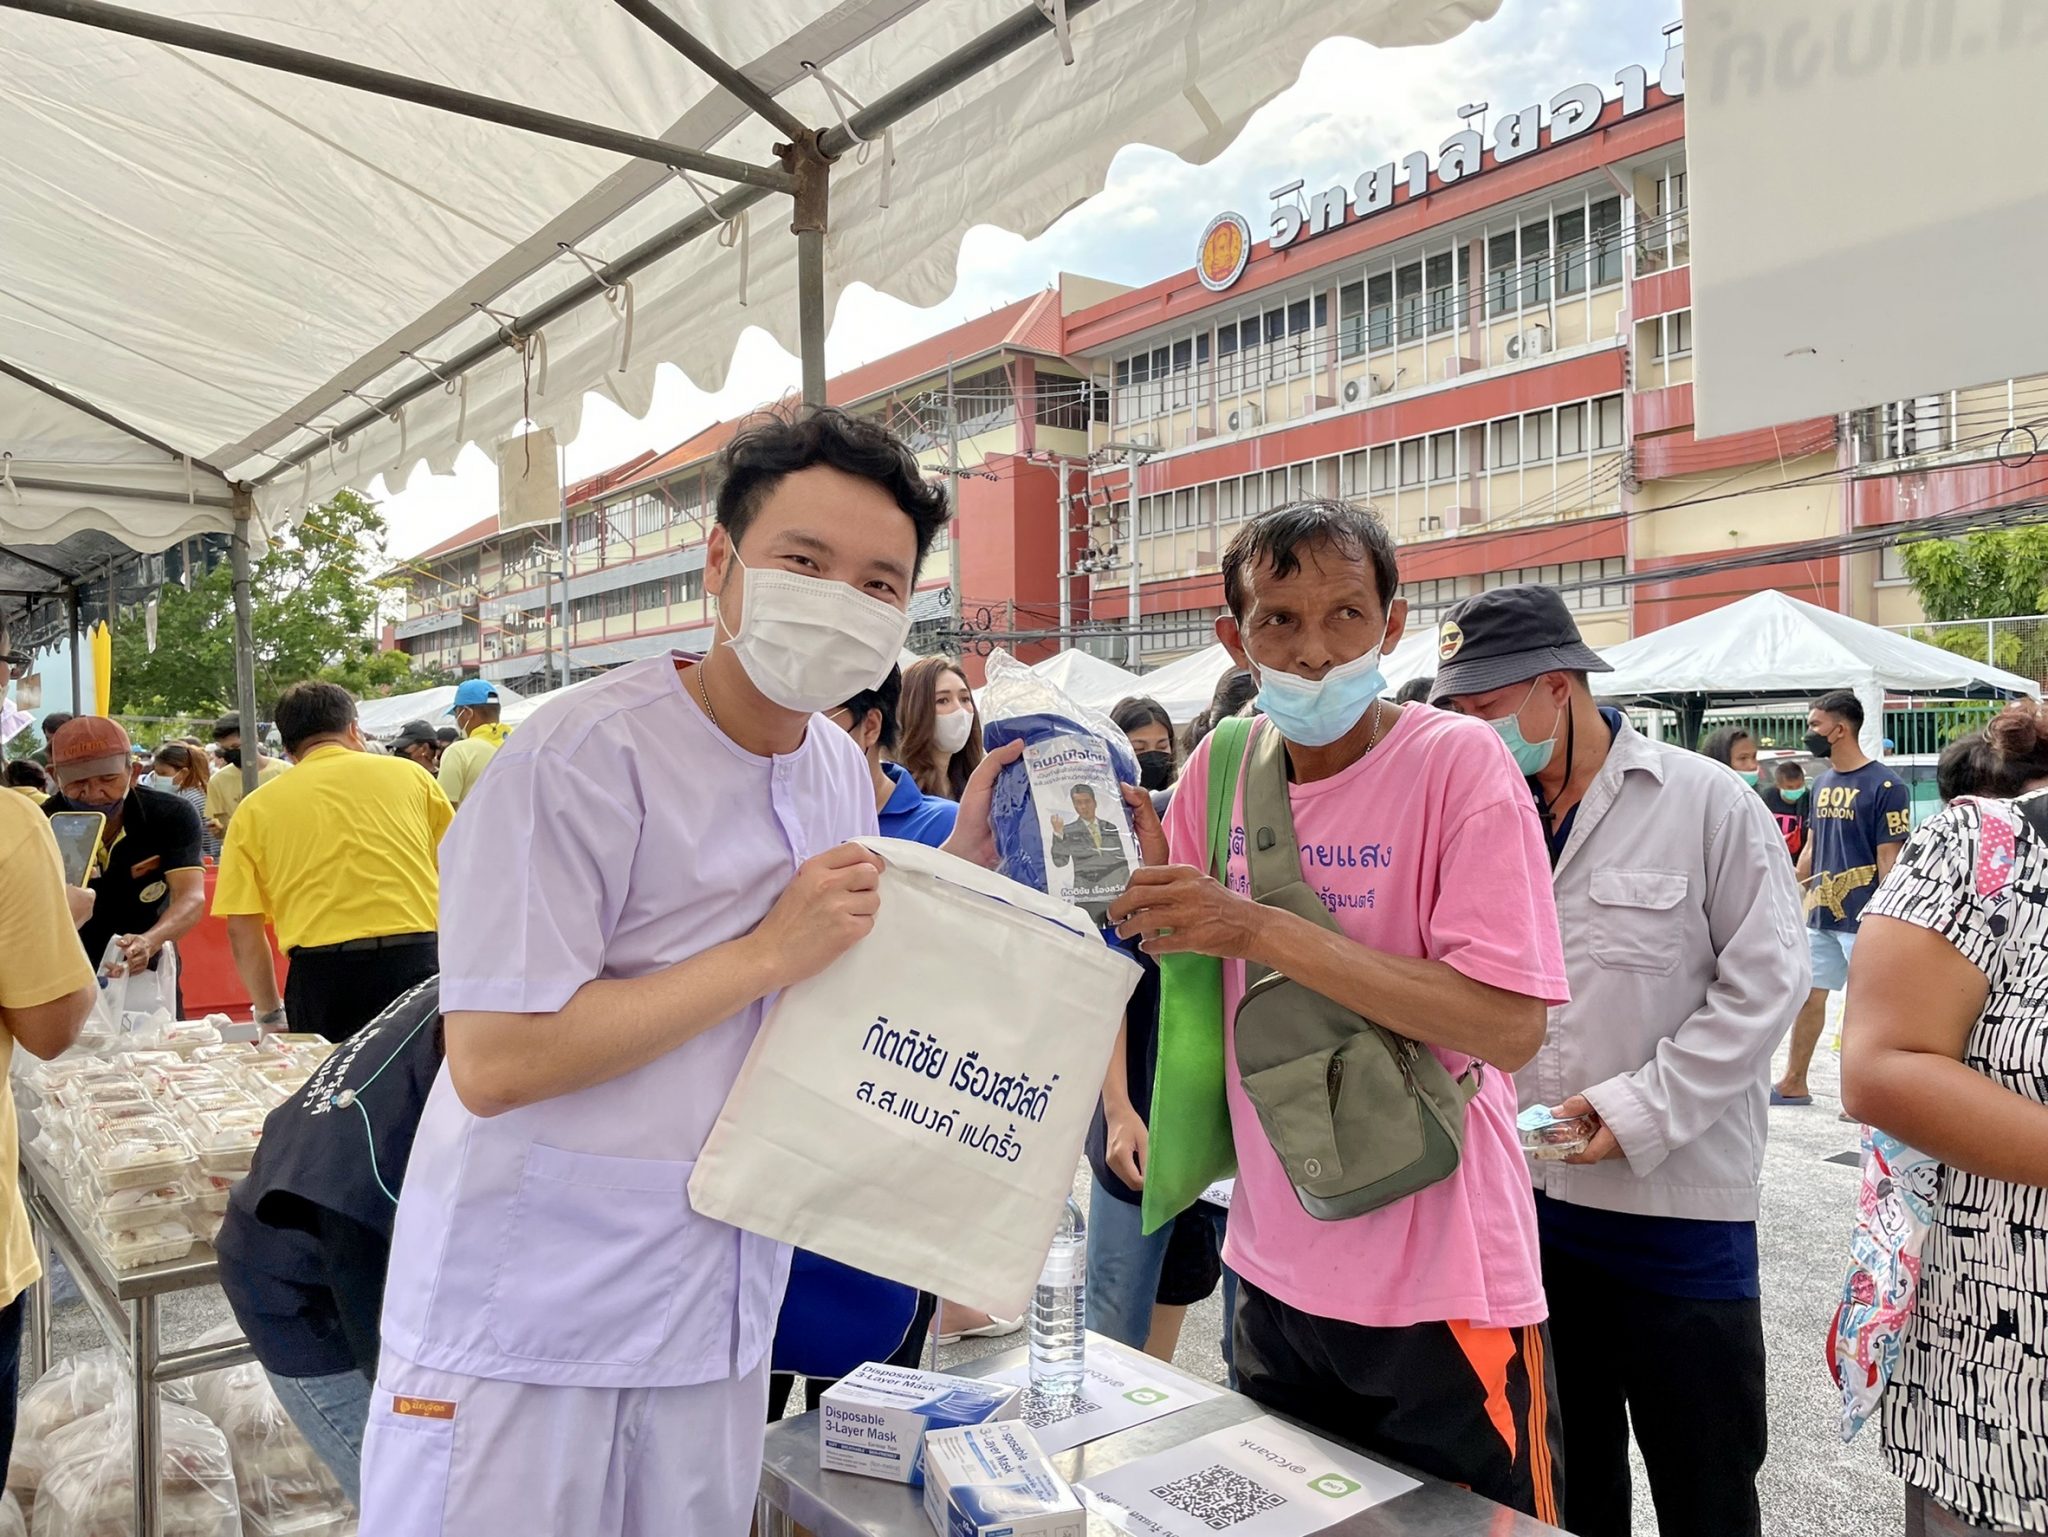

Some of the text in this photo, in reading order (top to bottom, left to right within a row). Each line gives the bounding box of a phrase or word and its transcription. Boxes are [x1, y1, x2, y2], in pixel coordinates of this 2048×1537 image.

[1817, 787, 1859, 807] BOY
[1816, 808, 1854, 821] LONDON
[1299, 843, 1392, 868] ายแสง
[1315, 886, 1375, 913] รัฐมนตรี
[861, 1015, 1060, 1123] กิตติชัย เรืองสวัสดิ์
[856, 1080, 1022, 1162] ส.ส.แบงค์ แปดริ้ว
[855, 1372, 902, 1387] 3-Layer
[902, 1380, 938, 1393] Mask
[861, 1366, 923, 1381] Disposabl
[825, 1405, 885, 1426] Disposable
[825, 1419, 897, 1443] 3-Layer Mask
[997, 1454, 1016, 1475] Mask
[1239, 1438, 1307, 1475] @fcbank
